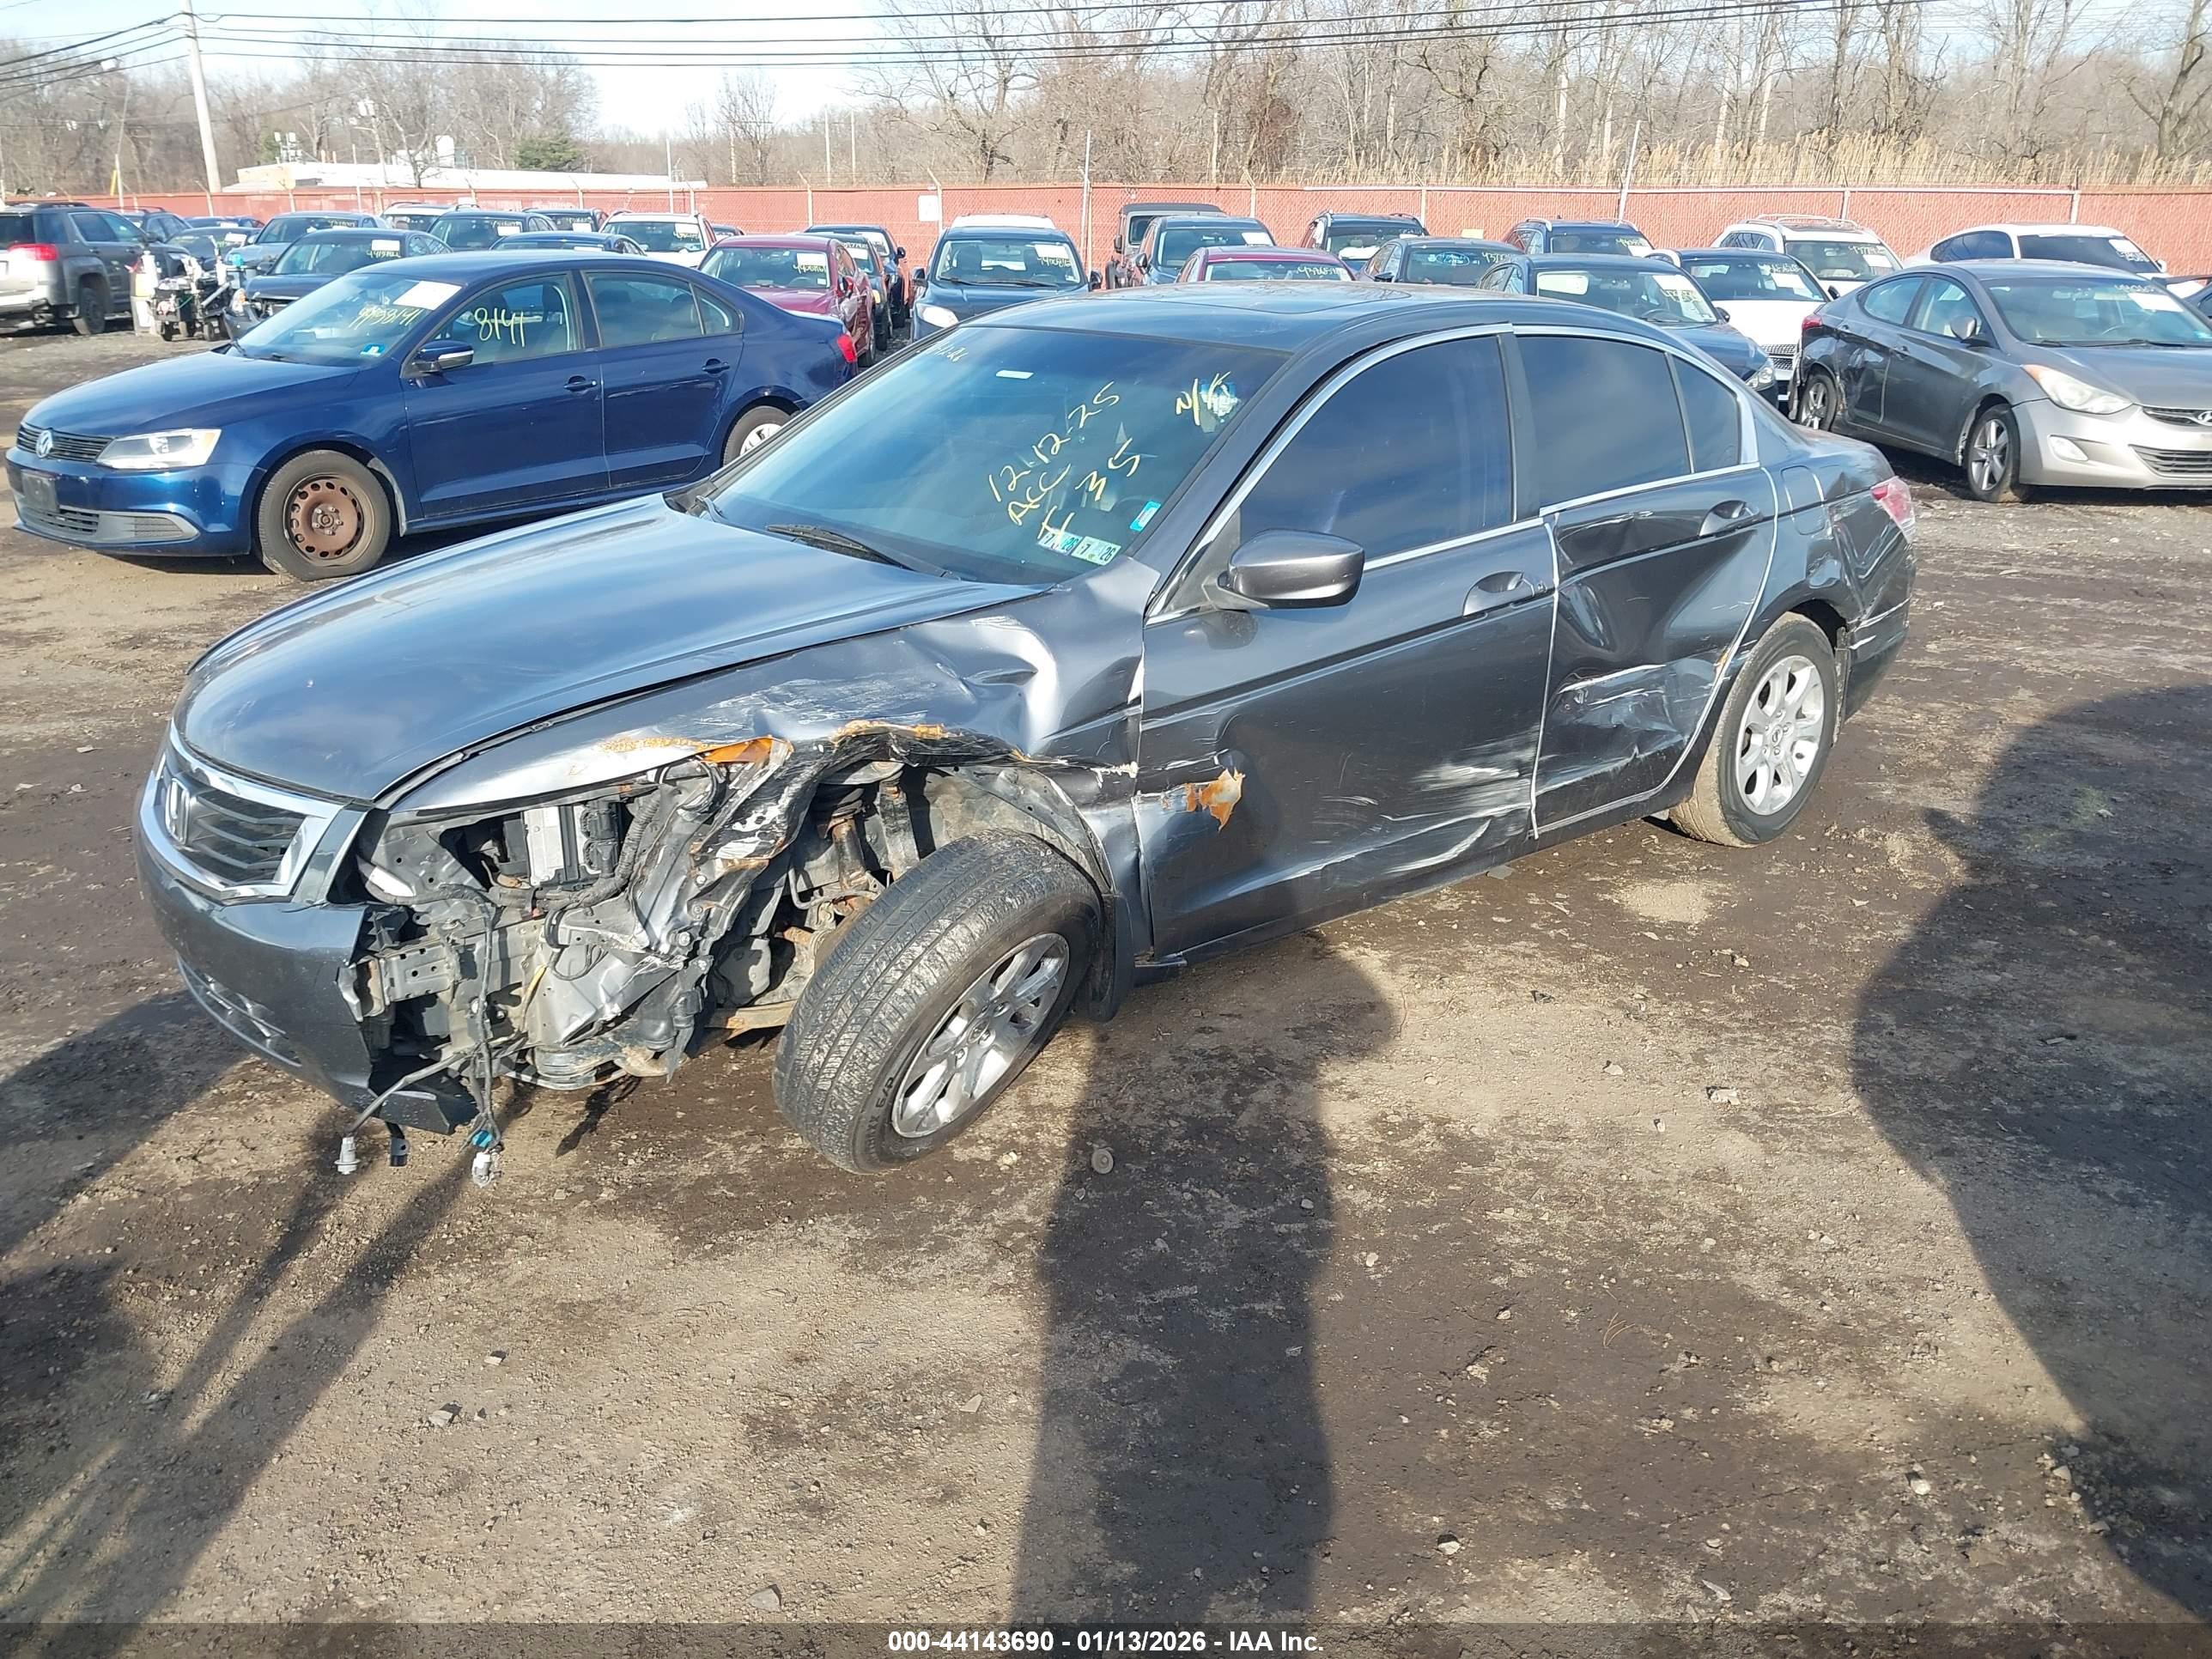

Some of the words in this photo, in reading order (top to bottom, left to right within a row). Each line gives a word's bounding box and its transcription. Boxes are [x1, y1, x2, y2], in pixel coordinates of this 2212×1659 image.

[474, 307, 525, 347] 8141
[1008, 463, 1072, 526] ACC
[1100, 546, 1116, 562] 26
